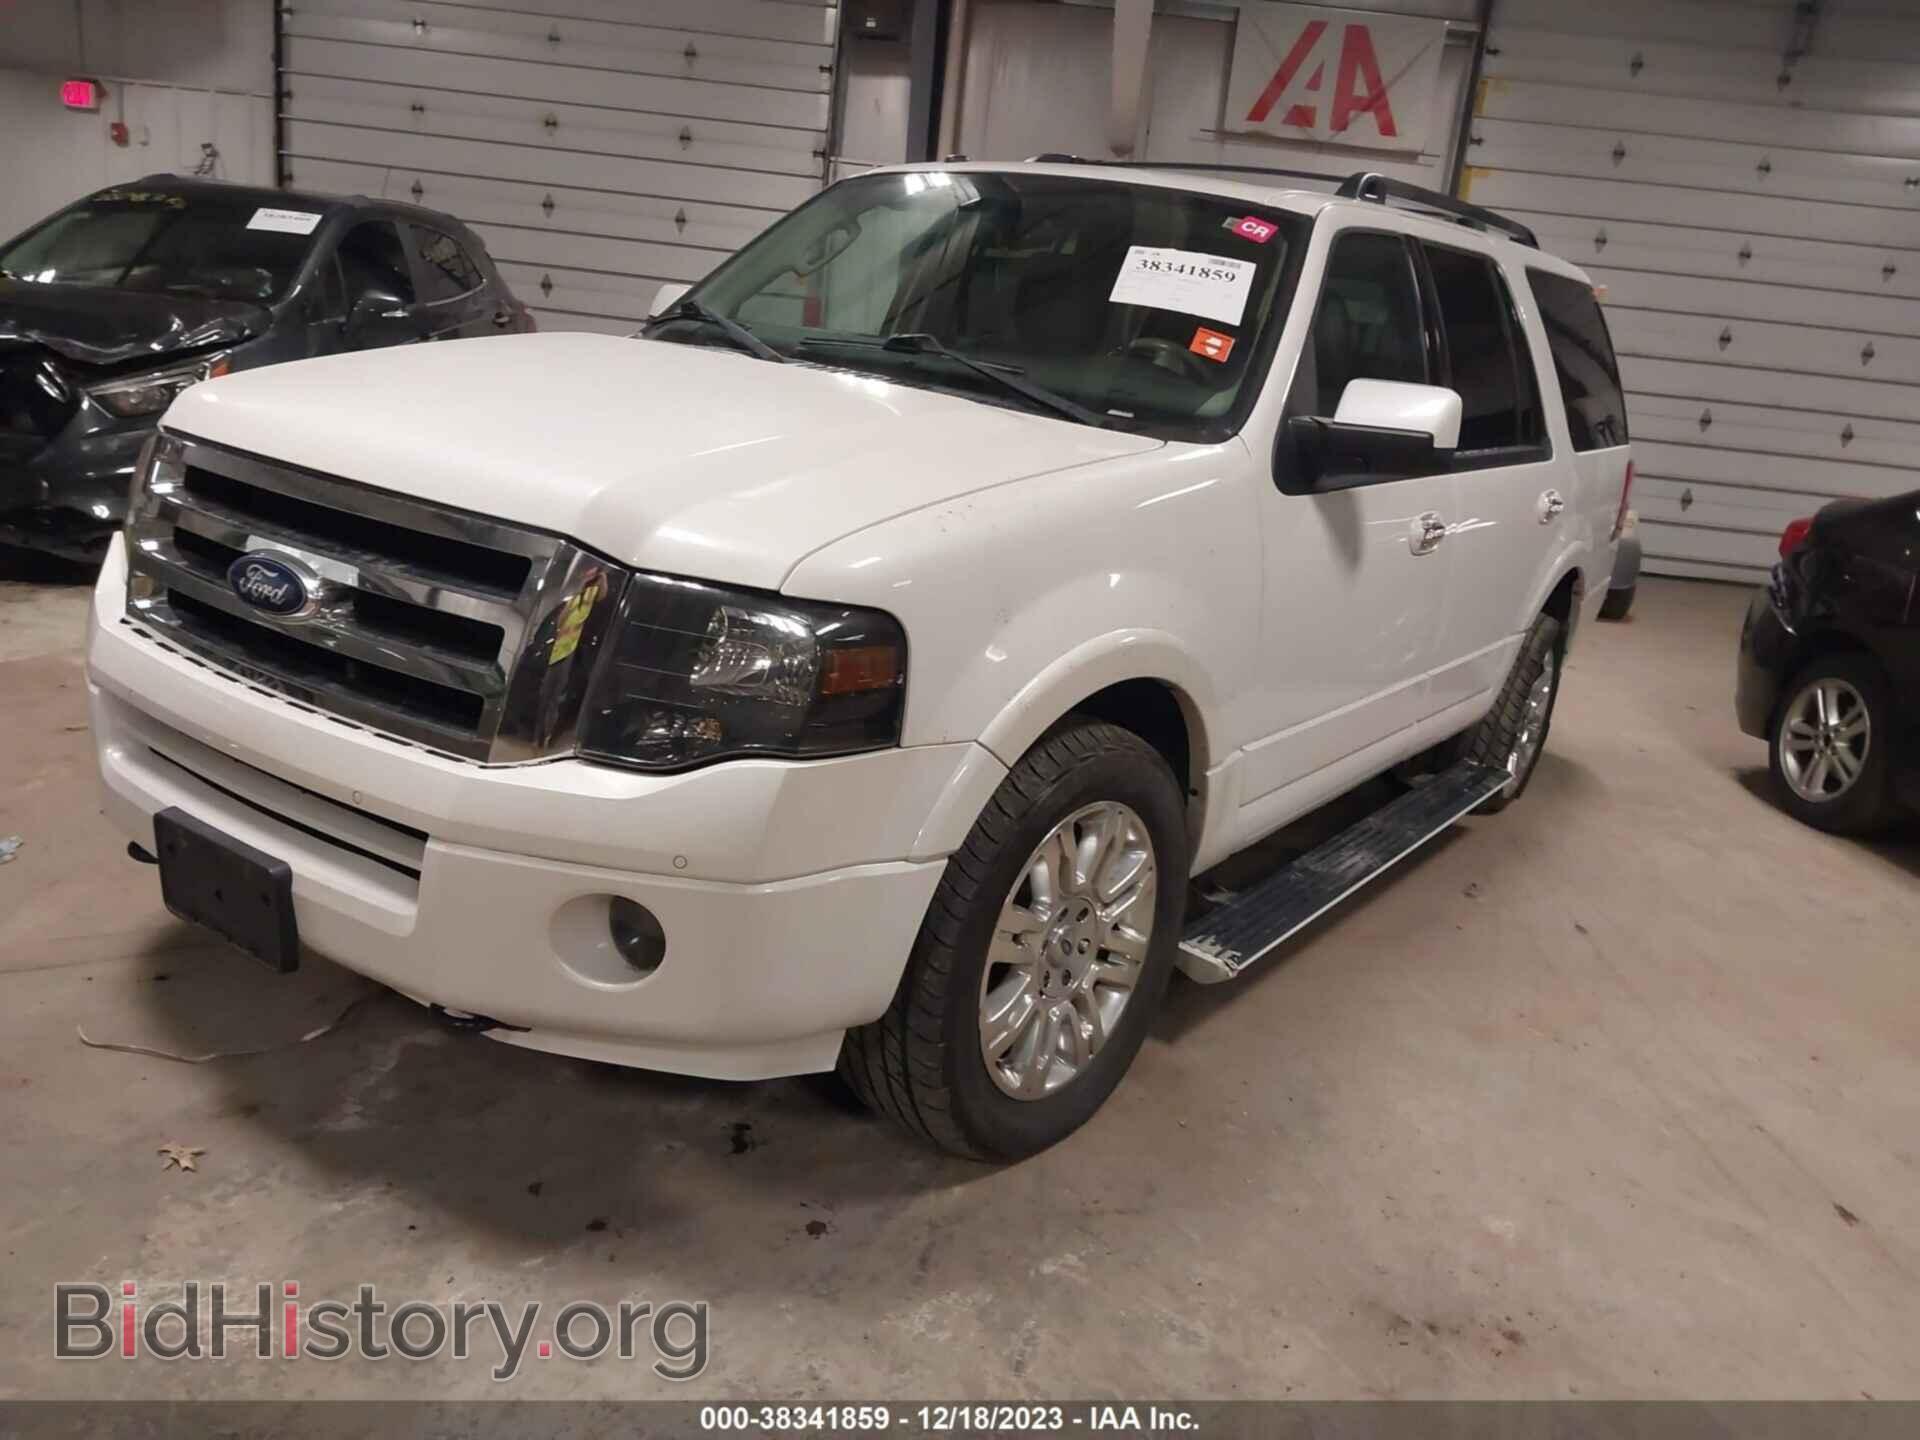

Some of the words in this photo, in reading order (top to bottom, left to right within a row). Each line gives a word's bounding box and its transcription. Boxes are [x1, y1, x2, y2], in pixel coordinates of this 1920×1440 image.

[1241, 221, 1270, 238] CR
[1135, 258, 1237, 283] 38341859
[239, 564, 290, 605] Ford
